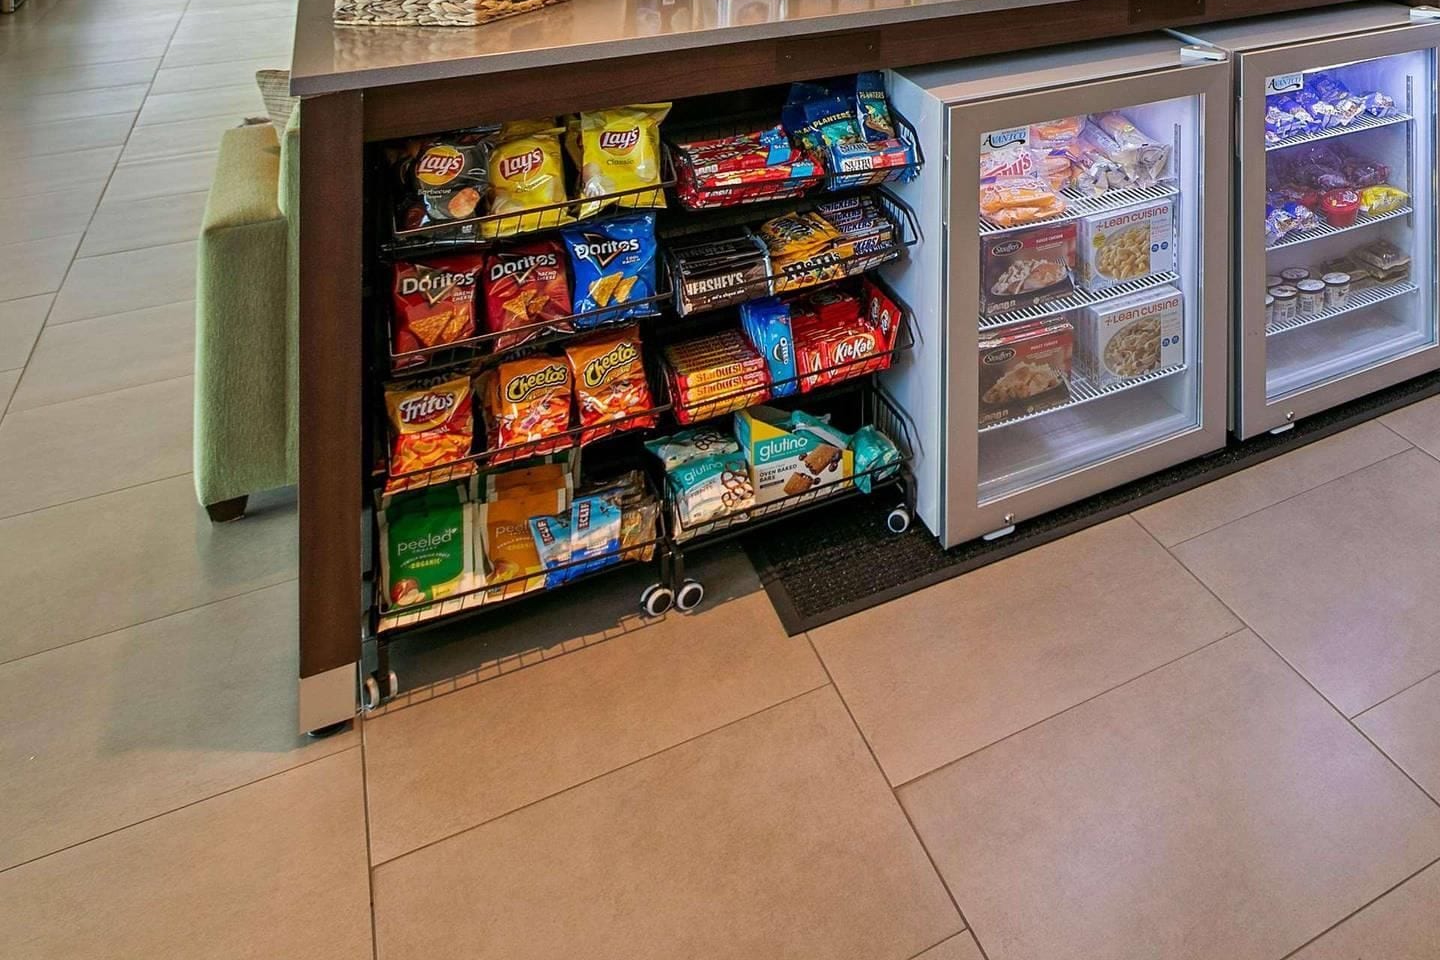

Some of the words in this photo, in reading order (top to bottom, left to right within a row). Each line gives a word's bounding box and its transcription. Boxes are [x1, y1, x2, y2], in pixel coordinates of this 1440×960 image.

[814, 110, 851, 128] PLANTERS
[601, 128, 640, 148] Lay's
[983, 131, 1027, 148] AVANTCO
[417, 153, 464, 174] Lay's
[502, 148, 545, 177] Lay's
[574, 238, 640, 260] Doritos
[491, 252, 557, 280] Doritos
[403, 272, 475, 295] Doritos
[686, 271, 745, 296] HERSHEY'S
[780, 336, 790, 366] OREO
[584, 342, 640, 387] Cheetos
[505, 365, 569, 401] Cheetos
[400, 393, 454, 423] Fritos
[760, 437, 808, 461] glutino
[684, 461, 723, 485] glutino
[760, 469, 776, 478] OVEN
[397, 529, 452, 556] peeled
